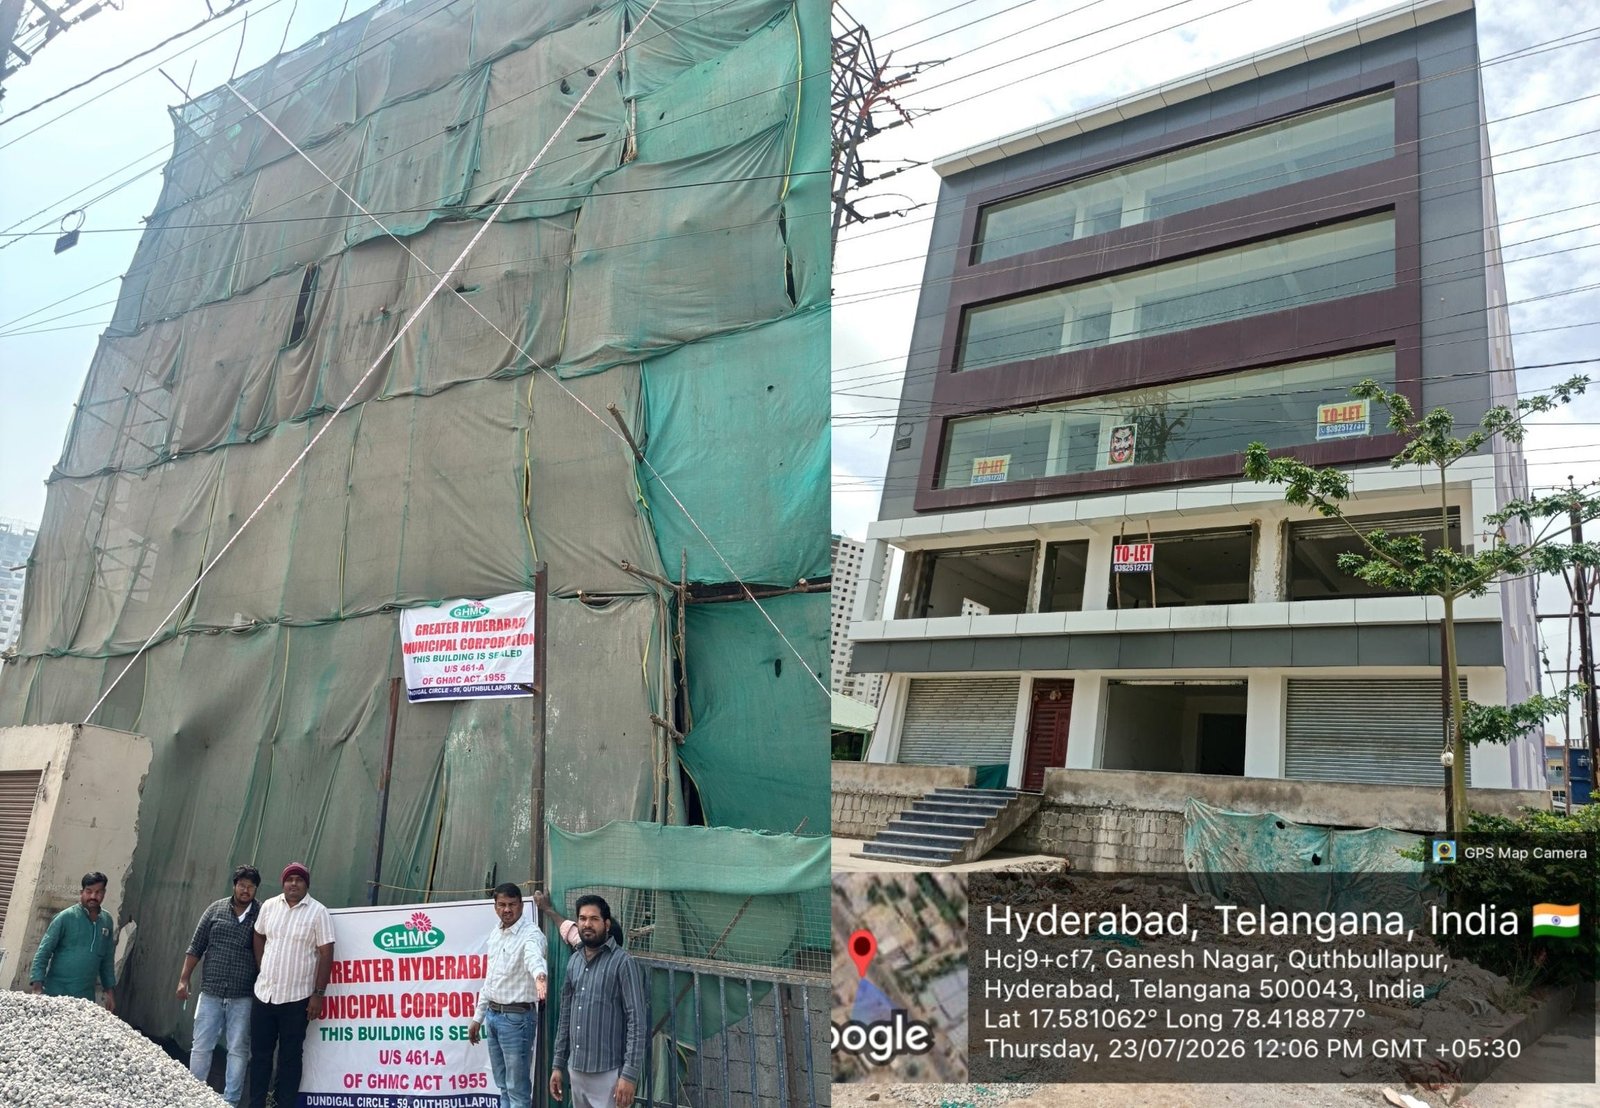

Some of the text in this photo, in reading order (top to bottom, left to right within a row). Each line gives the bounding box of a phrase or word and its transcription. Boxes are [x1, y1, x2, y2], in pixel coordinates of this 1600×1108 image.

[1323, 405, 1361, 423] TO-LET
[977, 459, 1004, 474] TO-LET
[1115, 544, 1153, 562] TO-LET
[453, 607, 486, 617] GHMC
[415, 621, 459, 636] GREATER
[403, 638, 458, 655] MUNICIPAL
[413, 654, 431, 664] THIS
[433, 652, 474, 662] BUILDING
[477, 652, 486, 660] IS
[461, 663, 485, 672] 461-A
[422, 673, 506, 685] OF GHMC ACT 1955
[380, 929, 438, 947] GHMC
[329, 958, 395, 984] REATER
[318, 993, 397, 1020] UNICIPAL
[320, 1026, 353, 1041] THIS
[358, 1025, 425, 1041] BUILDING
[430, 1025, 443, 1040] IS
[379, 1050, 446, 1066] U/S 461-A
[343, 1072, 487, 1091] OF GHMC ACT 1955
[306, 1095, 354, 1107] DUNDIGAL
[357, 1096, 389, 1108] CIRCLE
